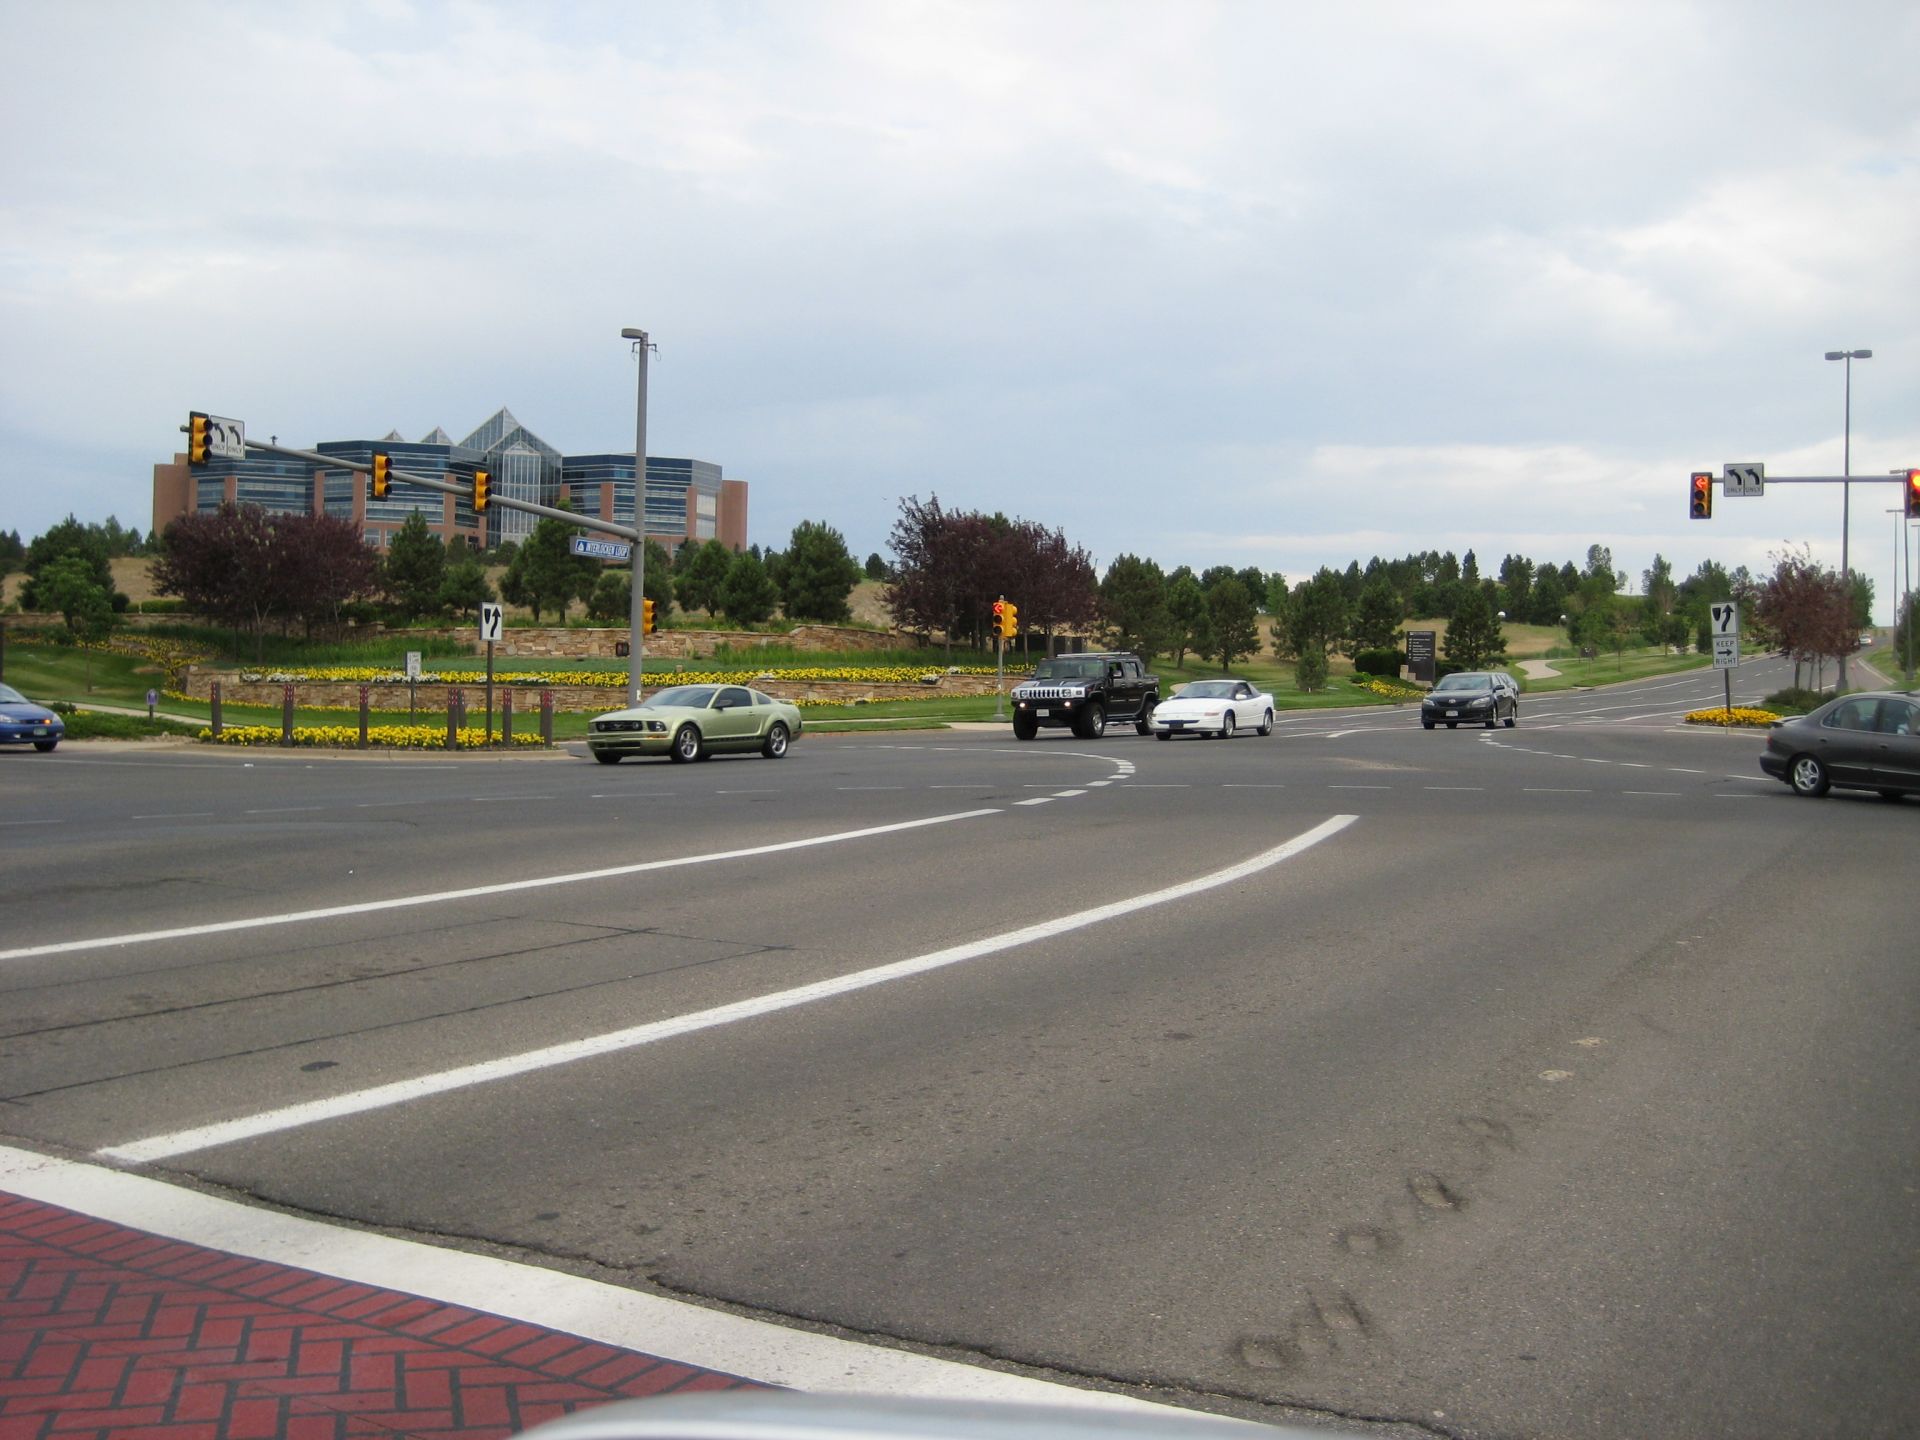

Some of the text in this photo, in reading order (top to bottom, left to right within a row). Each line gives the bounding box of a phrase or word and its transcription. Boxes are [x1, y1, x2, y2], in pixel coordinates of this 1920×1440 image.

[615, 545, 628, 557] LOOP
[1716, 640, 1735, 648] KEEP
[1715, 657, 1737, 665] RIGHT
